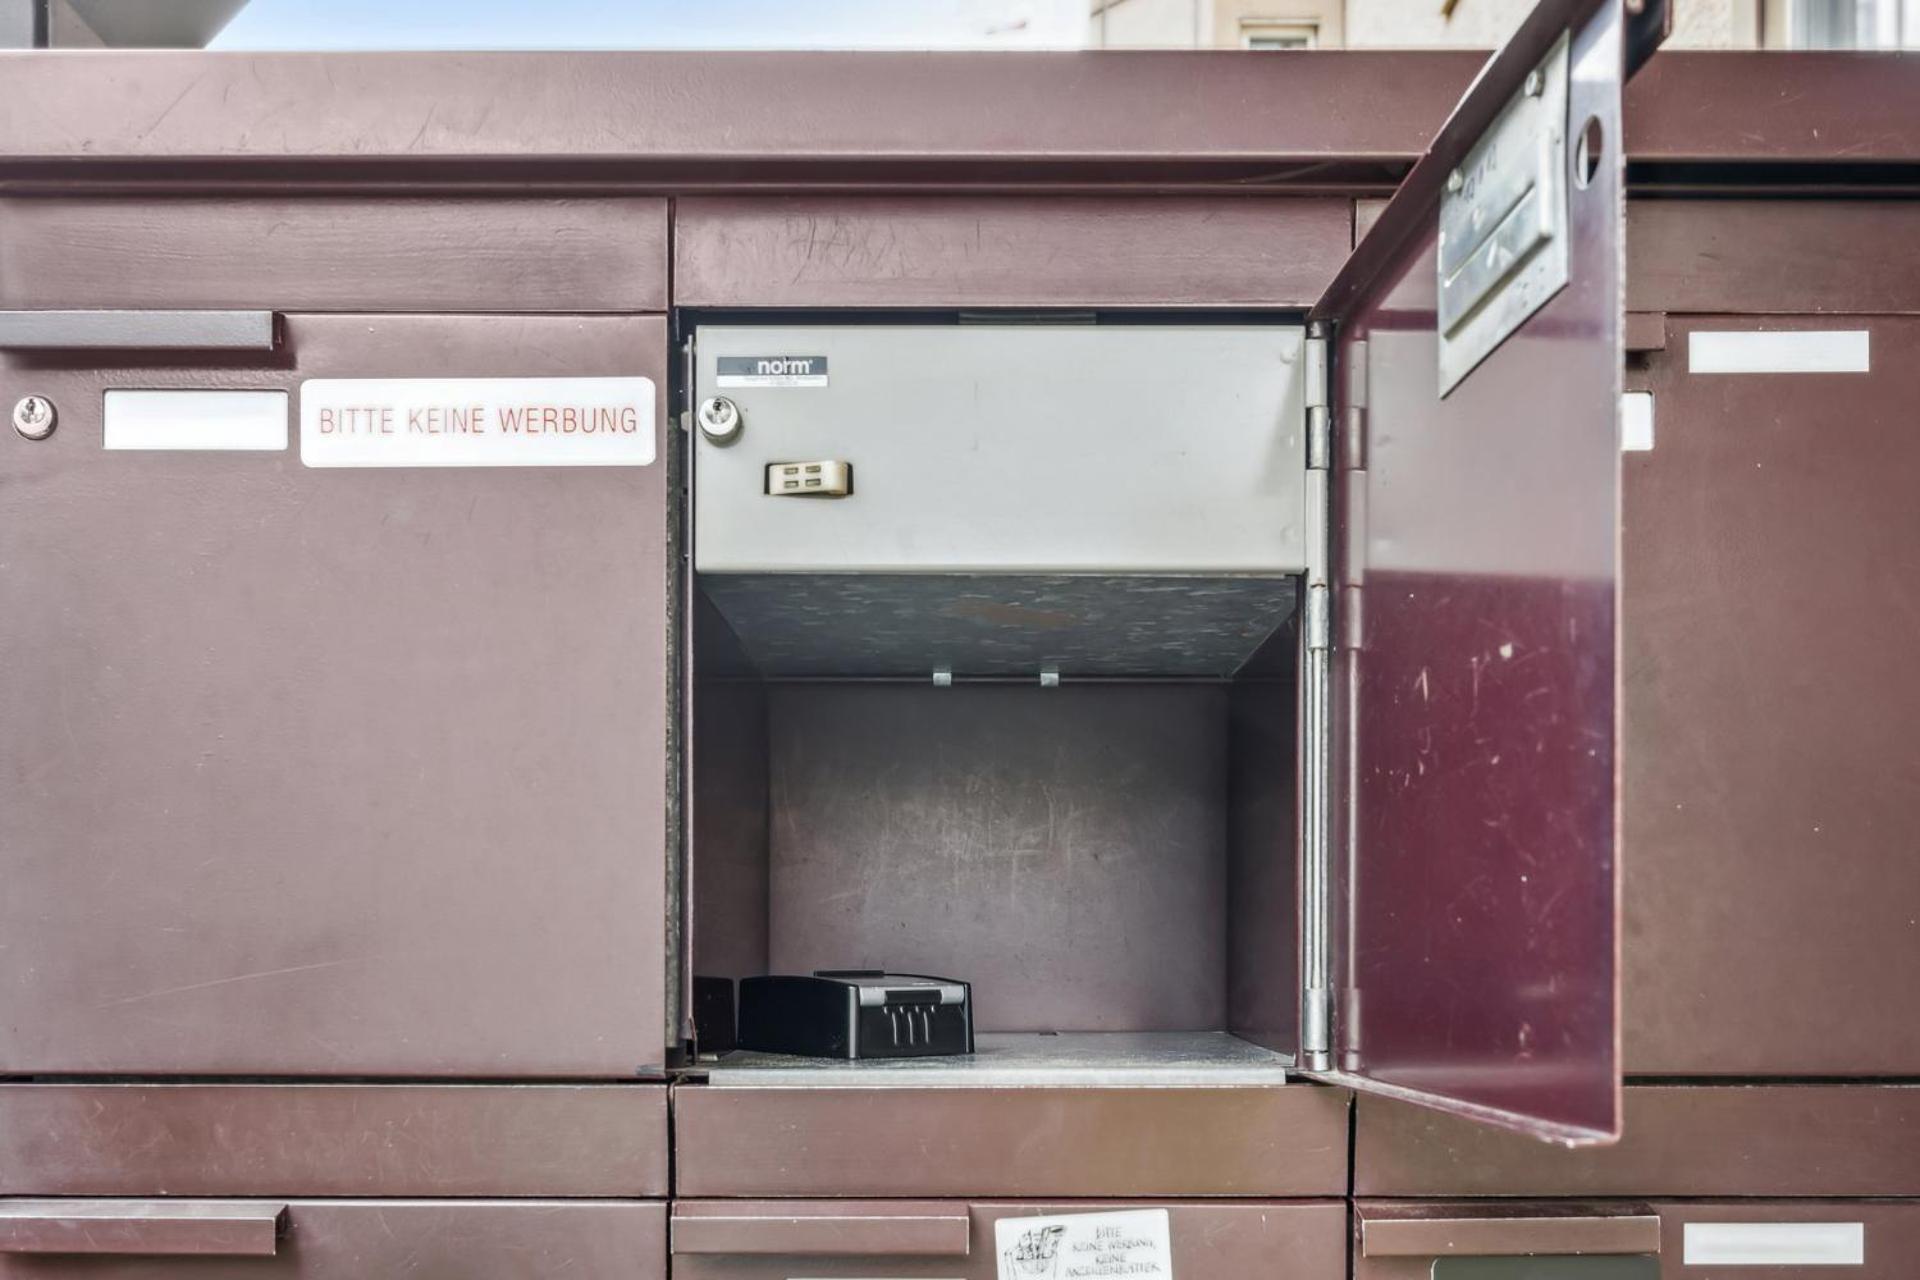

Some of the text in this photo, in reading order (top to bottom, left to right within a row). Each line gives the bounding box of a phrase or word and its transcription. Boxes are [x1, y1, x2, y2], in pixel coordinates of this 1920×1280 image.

[319, 407, 638, 434] BITTE KEINE WERBUNG
